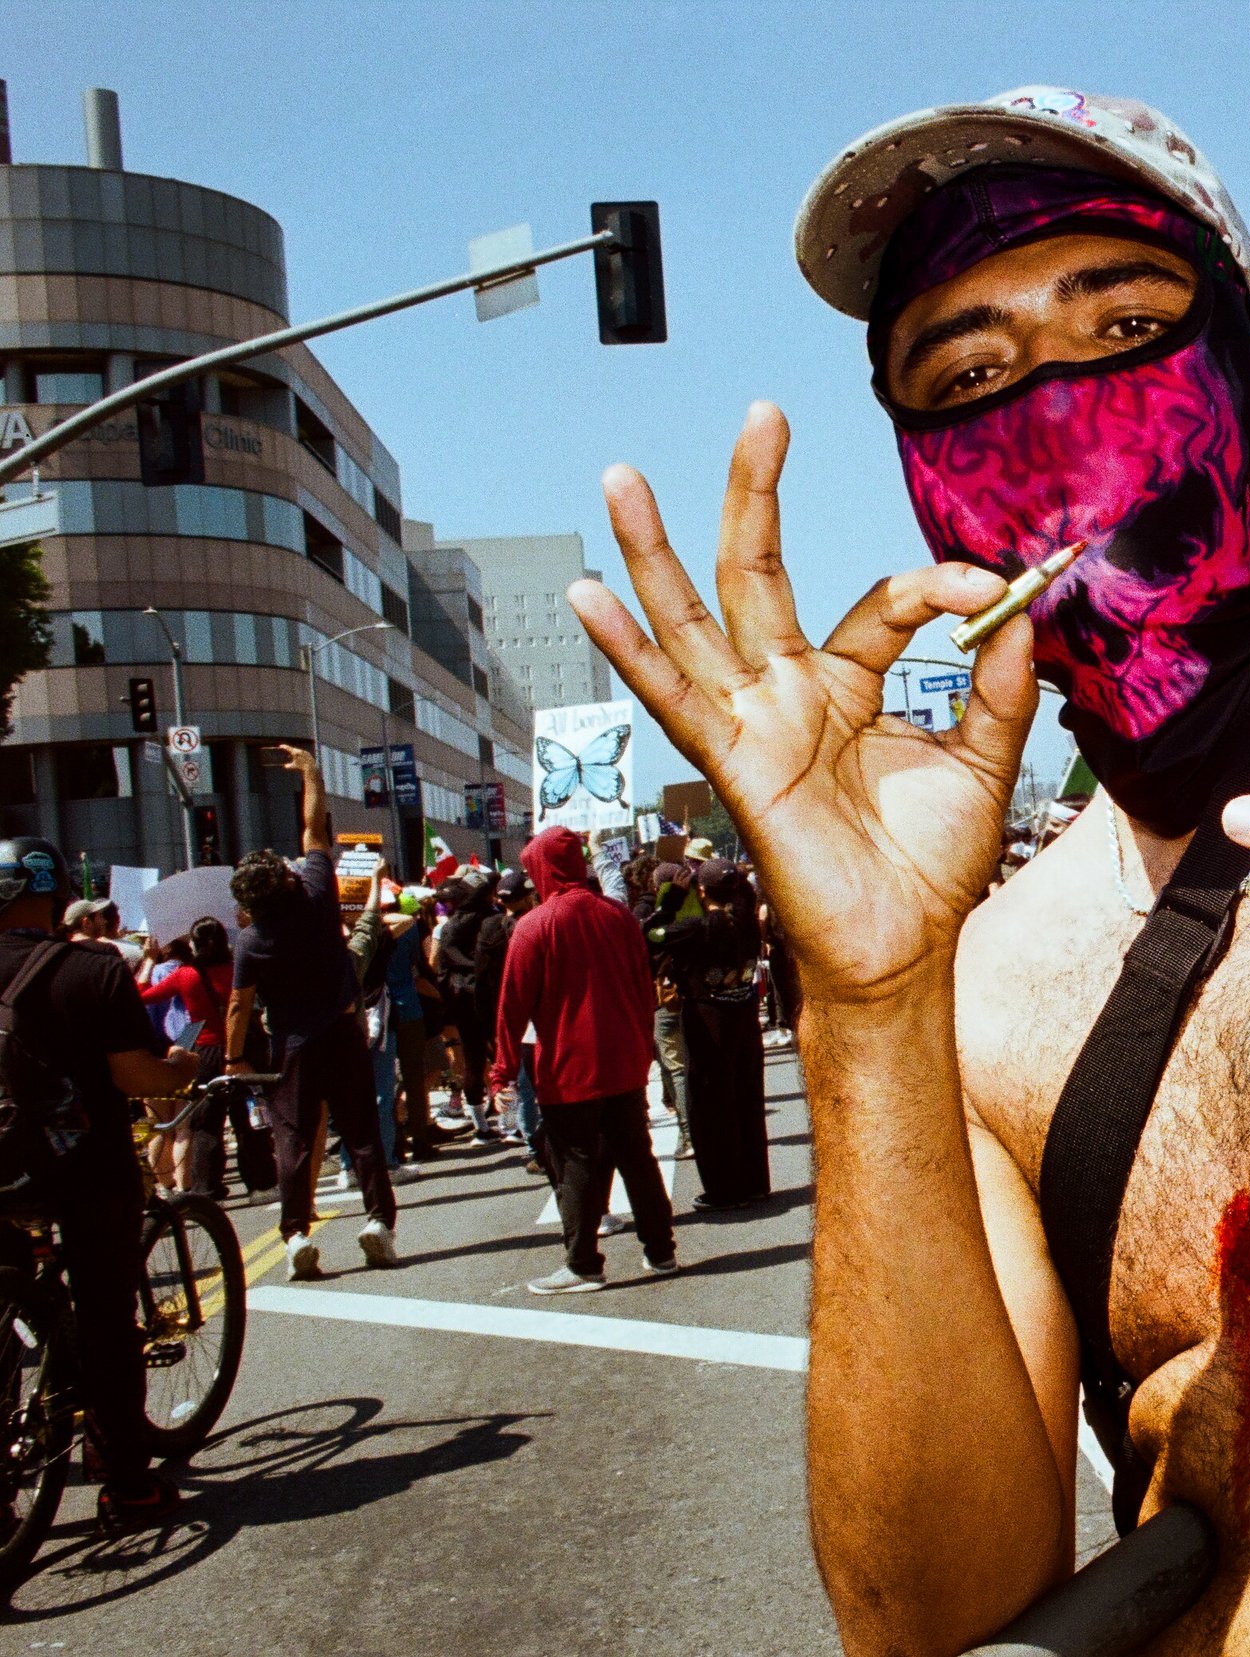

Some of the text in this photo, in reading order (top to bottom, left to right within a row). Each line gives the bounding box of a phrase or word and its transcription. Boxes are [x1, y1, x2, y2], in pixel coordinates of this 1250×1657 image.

[203, 424, 263, 457] Clinic
[923, 676, 967, 691] Temple St
